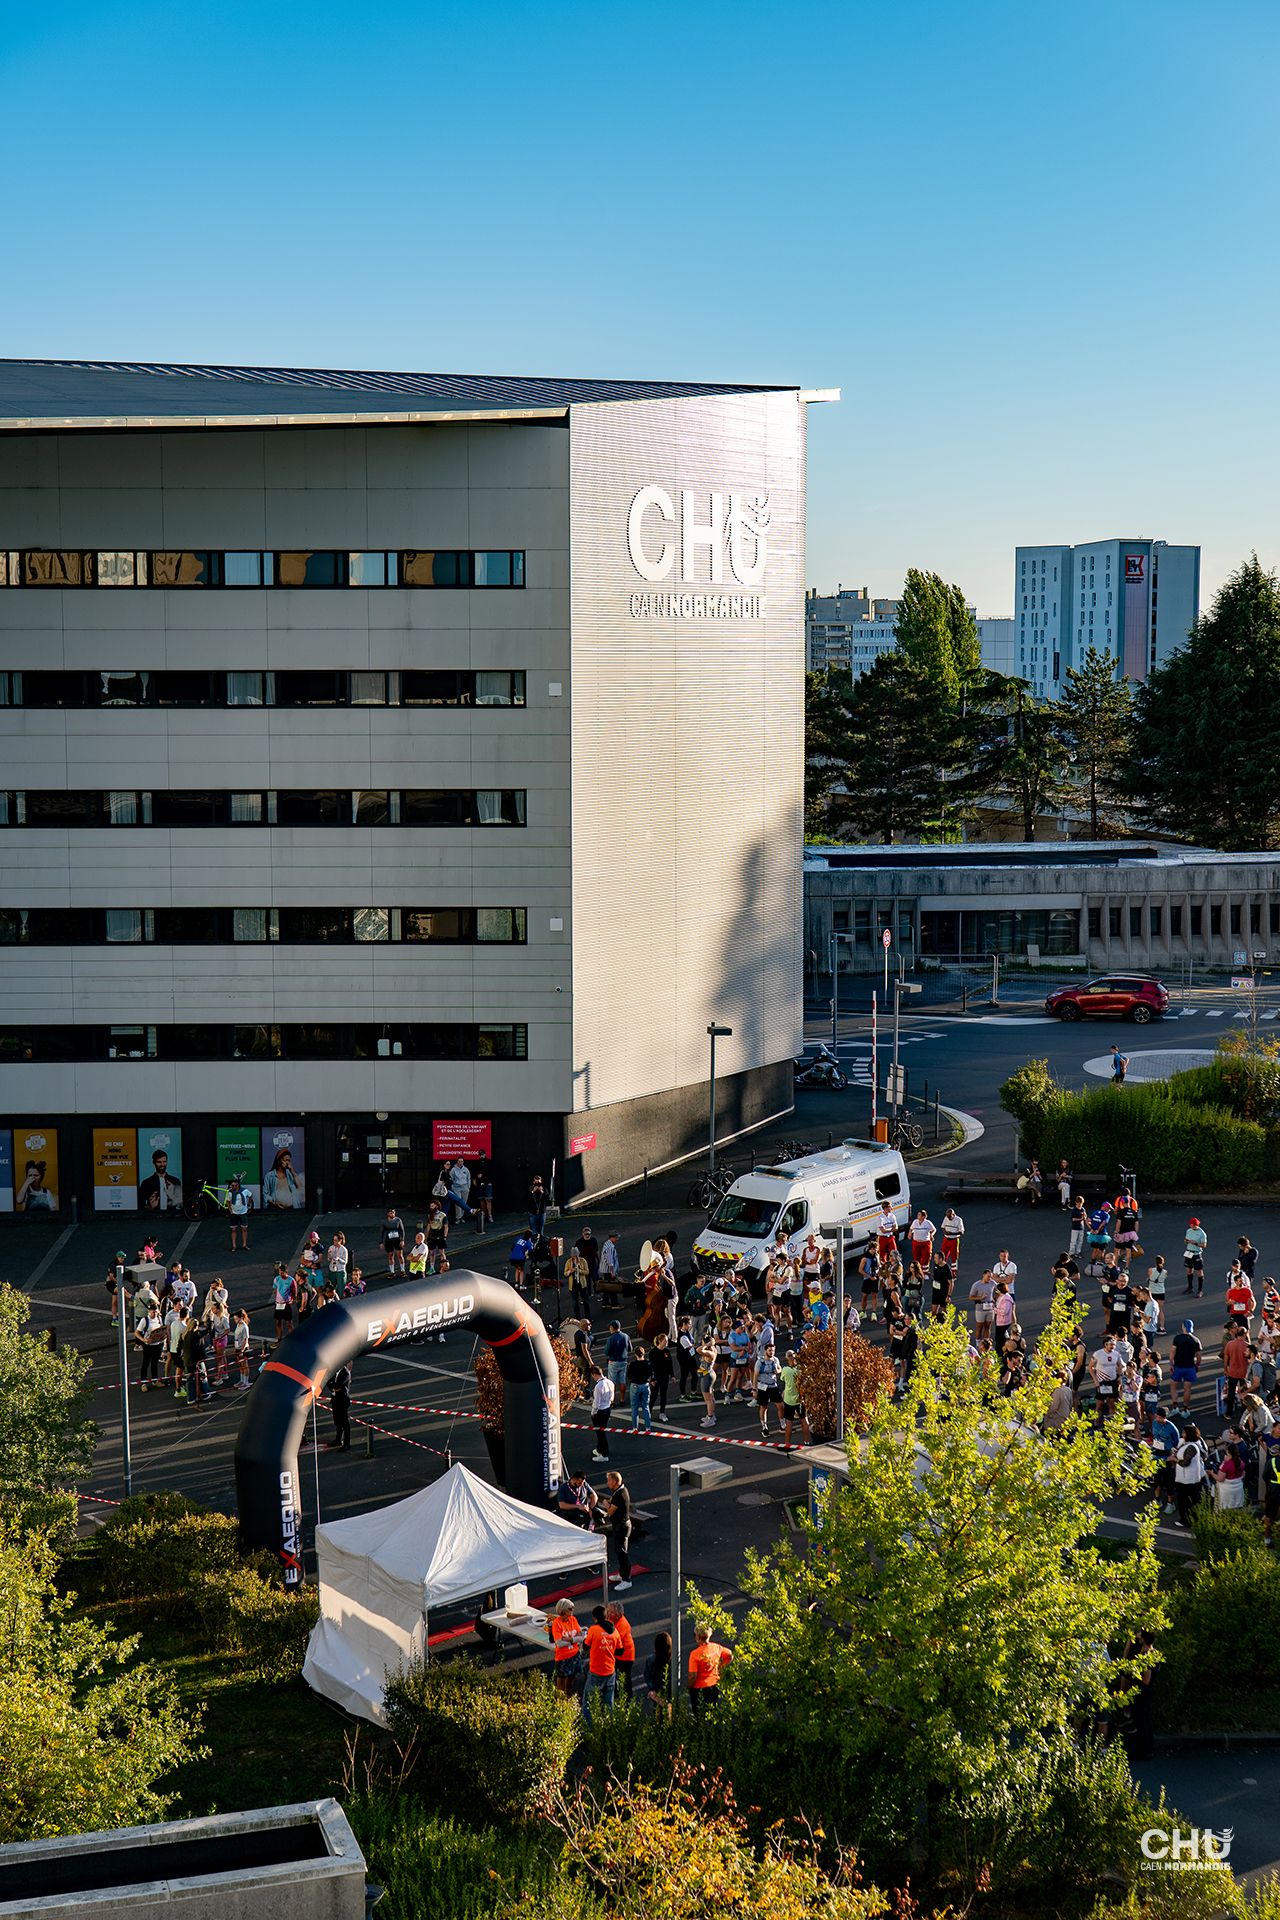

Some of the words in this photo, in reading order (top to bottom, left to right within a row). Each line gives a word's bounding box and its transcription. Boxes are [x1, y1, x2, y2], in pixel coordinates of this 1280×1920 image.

[627, 484, 770, 585] CHU
[629, 593, 664, 618] CAEN
[367, 1295, 475, 1347] EXAEQUO
[386, 1332, 411, 1343] SPORT
[280, 1471, 302, 1584] EXAEQUO
